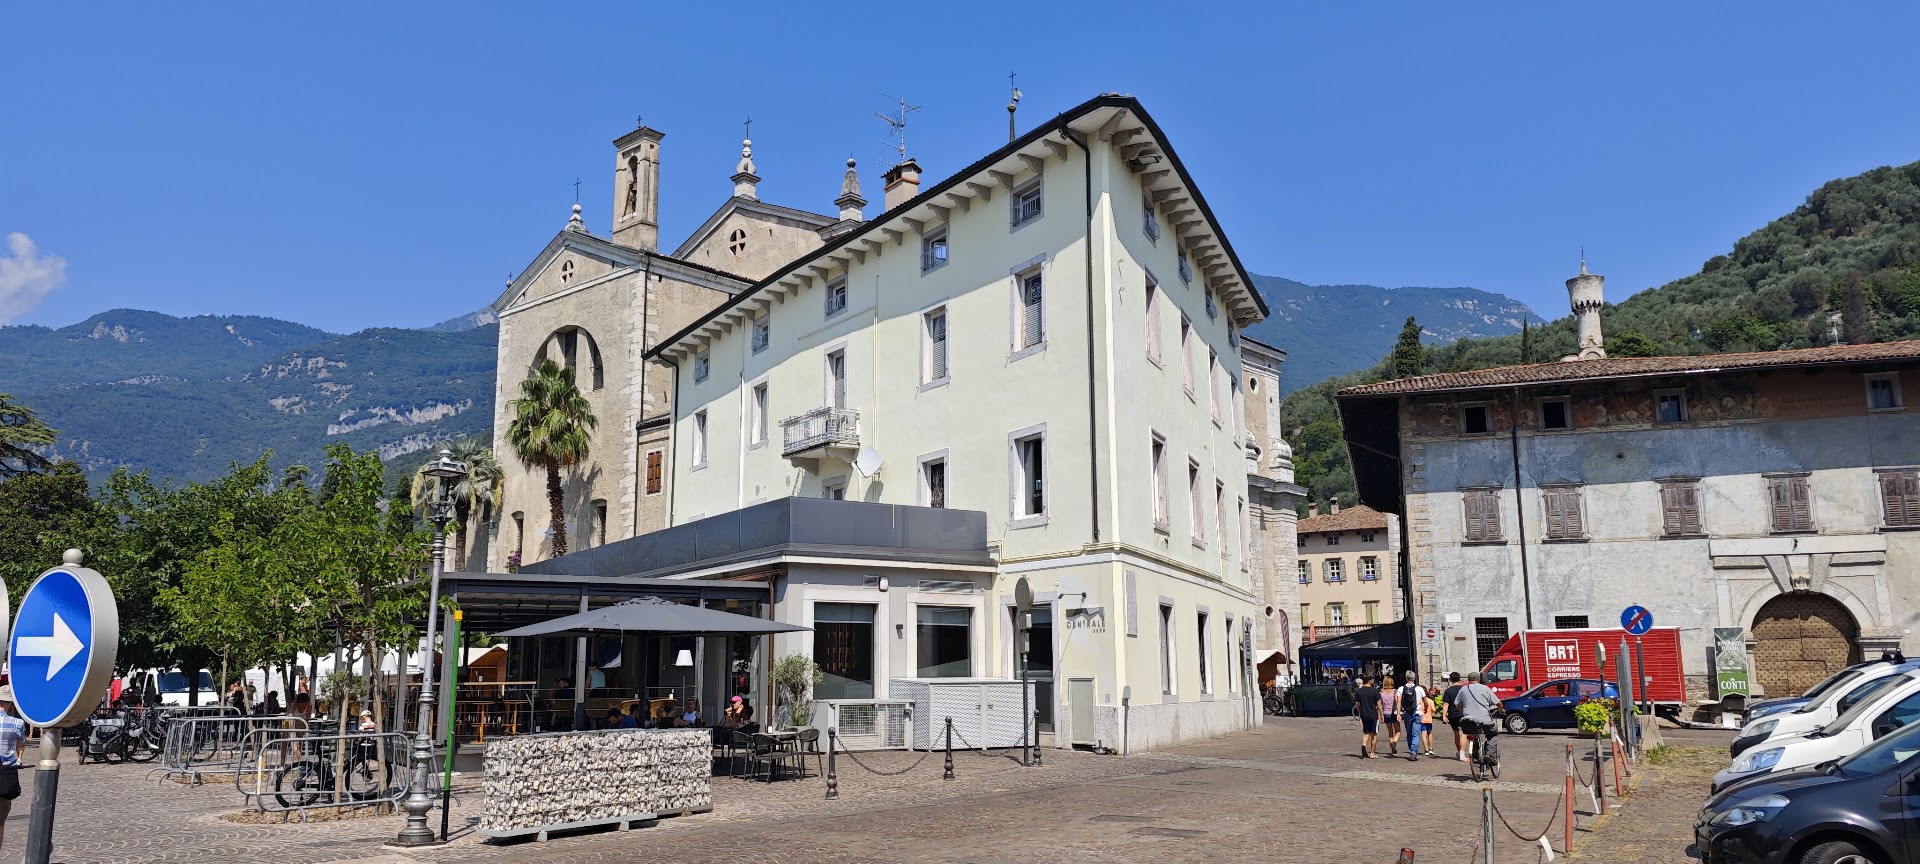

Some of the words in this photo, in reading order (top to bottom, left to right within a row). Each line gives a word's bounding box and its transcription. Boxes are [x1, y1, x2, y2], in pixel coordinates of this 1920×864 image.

[1066, 620, 1105, 629] CENTRALE
[1548, 646, 1575, 659] BRT
[1721, 681, 1746, 689] CONTI
